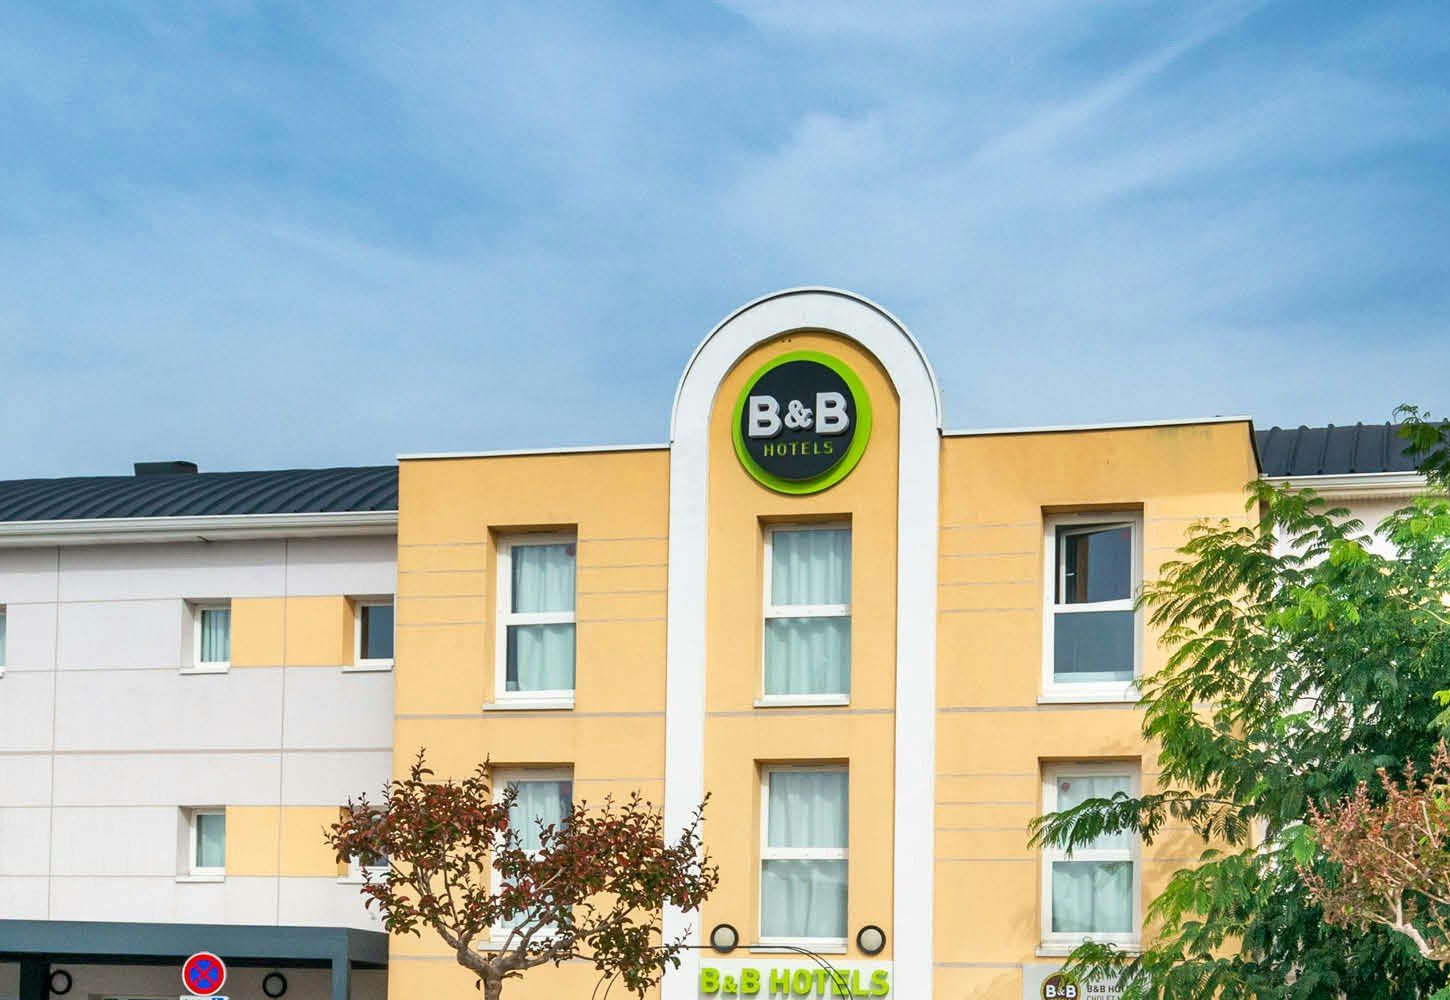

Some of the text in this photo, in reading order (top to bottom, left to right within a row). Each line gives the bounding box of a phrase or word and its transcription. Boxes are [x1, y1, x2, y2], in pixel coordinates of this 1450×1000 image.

[748, 391, 849, 439] B&B
[763, 441, 833, 457] HOTELS
[700, 967, 890, 997] B&B HOTELS
[1086, 985, 1106, 993] B&B
[1045, 984, 1077, 998] B&B
